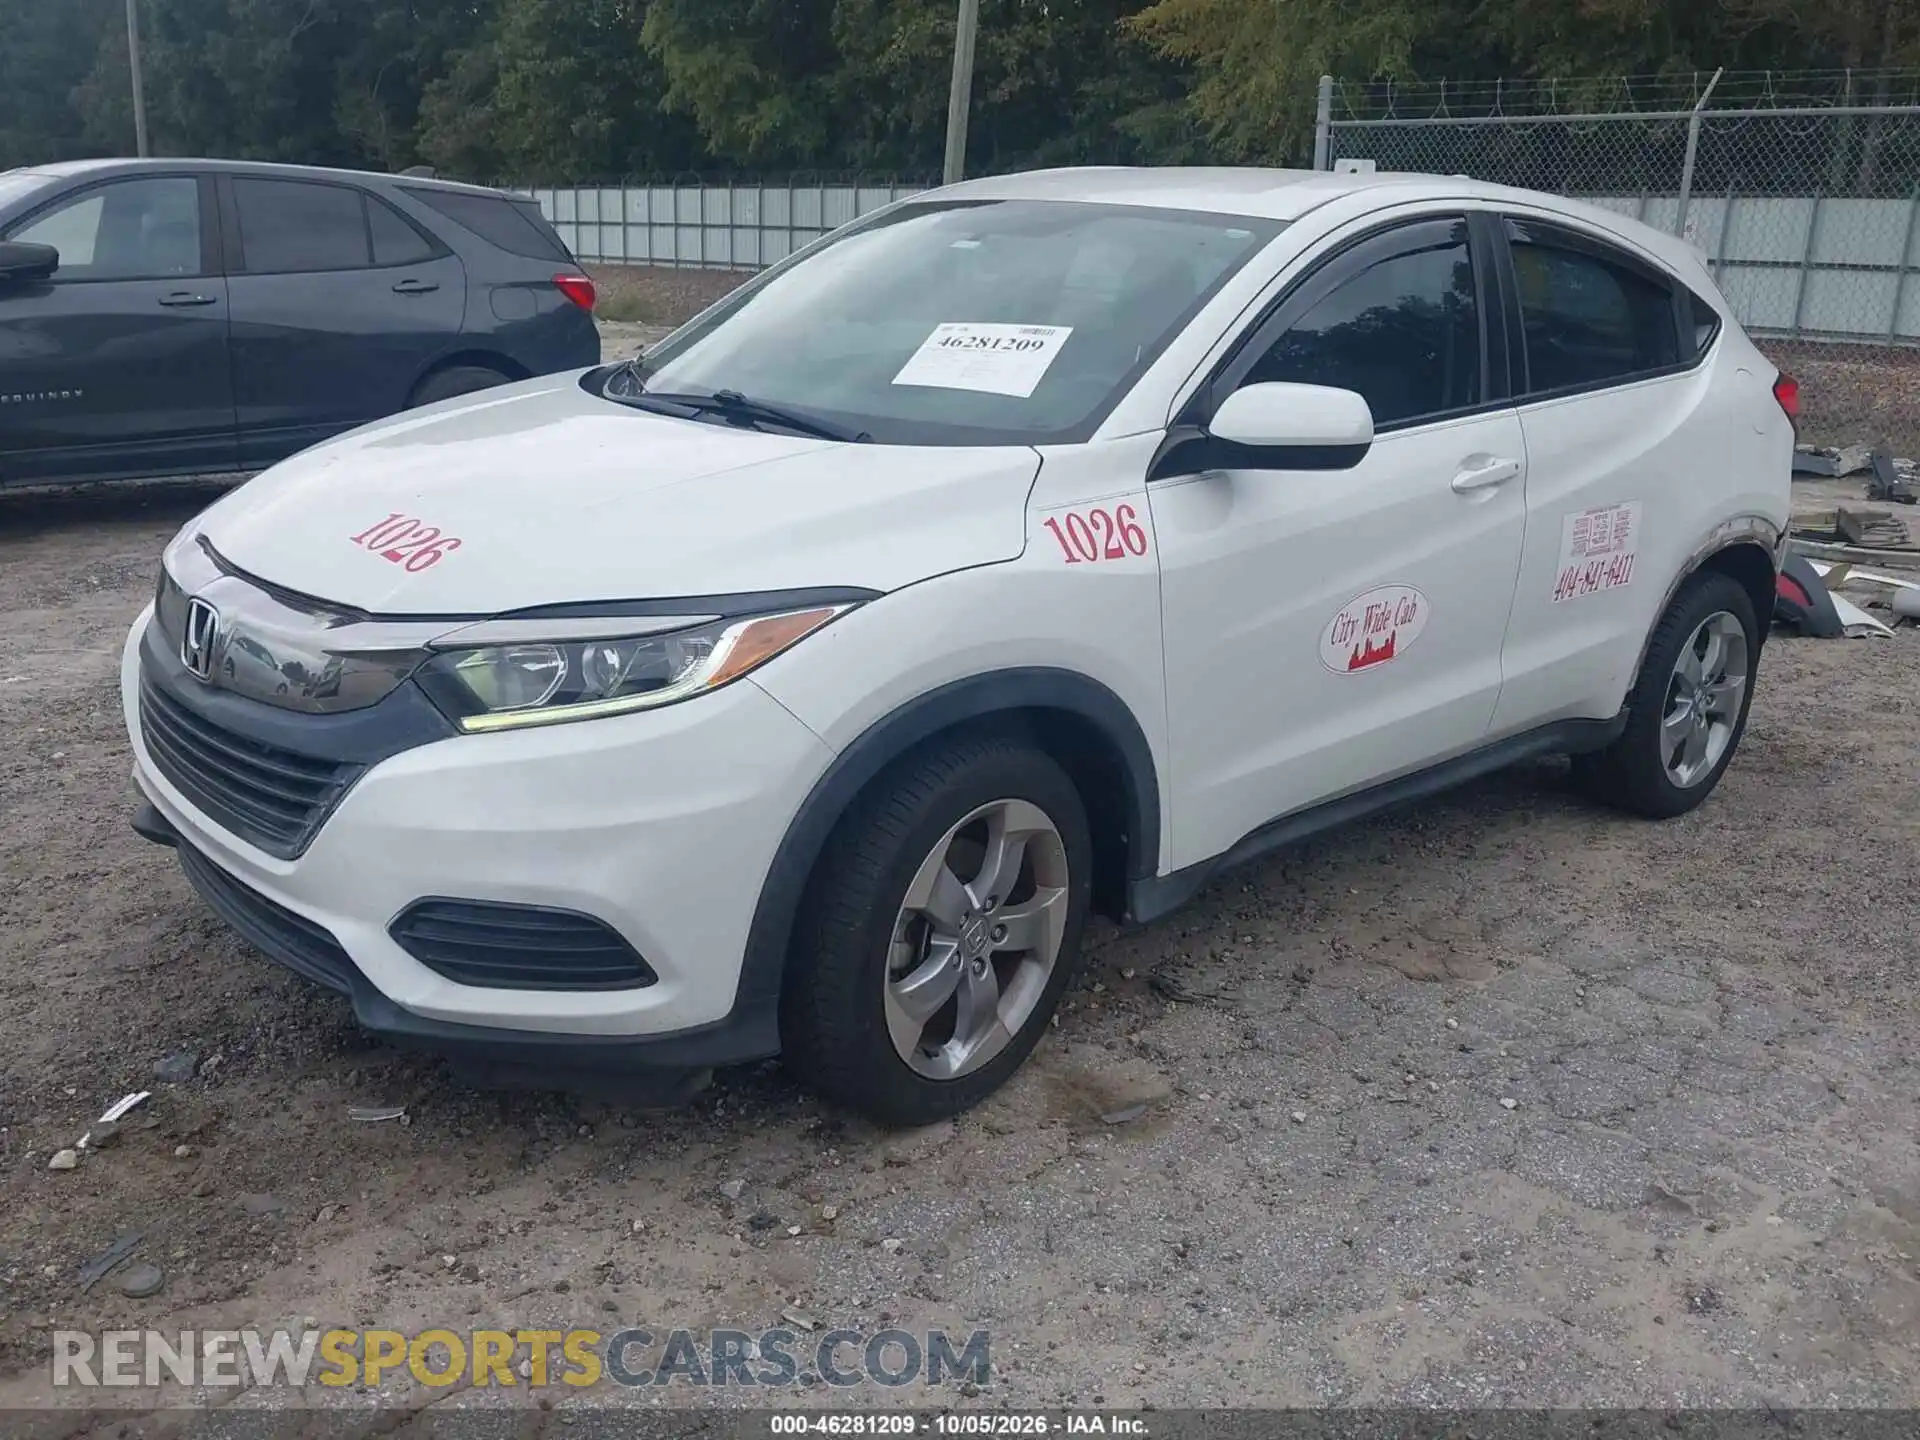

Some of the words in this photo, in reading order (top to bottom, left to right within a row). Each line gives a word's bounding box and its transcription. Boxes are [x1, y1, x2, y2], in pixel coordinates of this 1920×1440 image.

[938, 335, 1045, 352] 46281209
[349, 513, 462, 572] 1026
[1043, 504, 1147, 563] 1026
[1331, 611, 1360, 648] City
[1363, 601, 1391, 634] Wide
[1394, 593, 1417, 626] Cab
